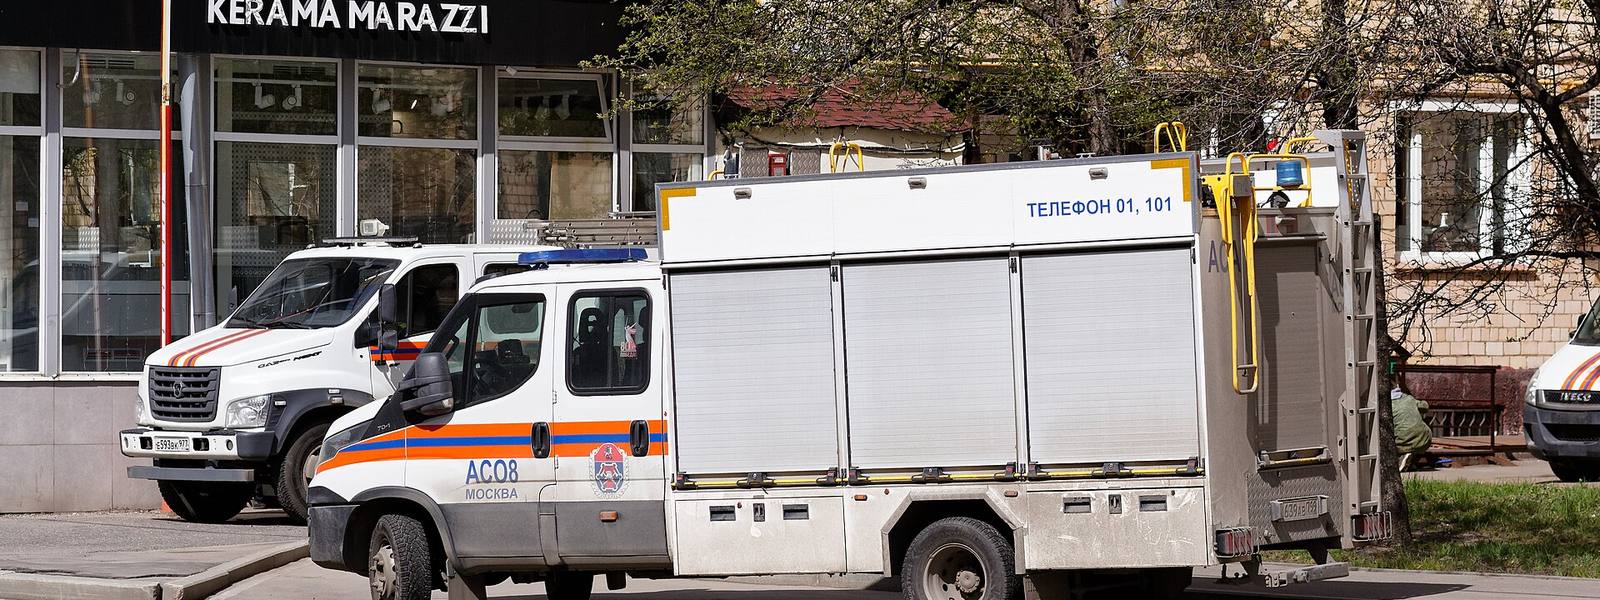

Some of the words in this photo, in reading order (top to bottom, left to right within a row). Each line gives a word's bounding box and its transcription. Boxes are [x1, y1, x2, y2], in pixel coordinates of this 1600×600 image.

[207, 0, 341, 28] KERAMA
[349, 1, 489, 34] MARAZZI
[1026, 198, 1111, 218] ТЕЛЕФОН
[1116, 198, 1140, 215] 01,
[1145, 196, 1172, 212] 101
[1561, 391, 1592, 402] IVECO
[465, 459, 519, 485] АСО8
[465, 487, 519, 500] МОСКВА
